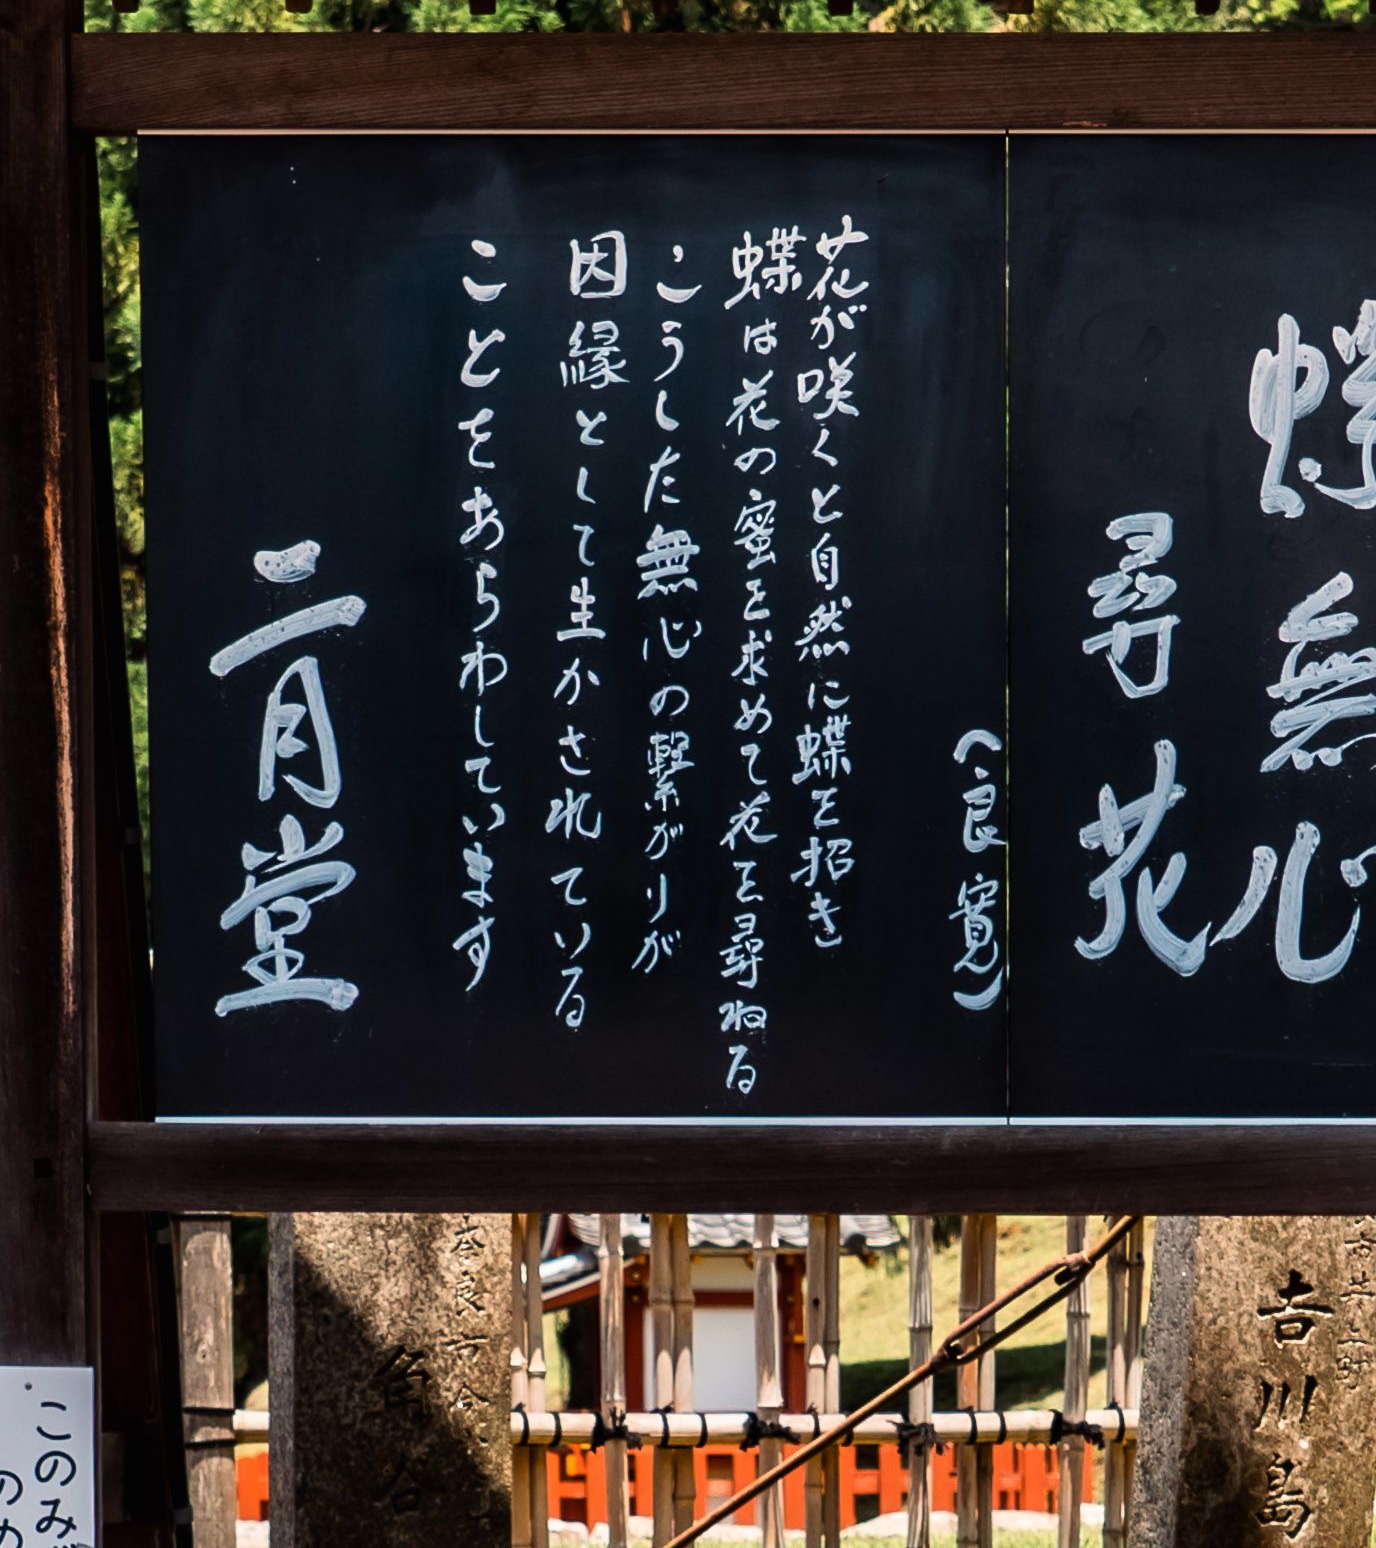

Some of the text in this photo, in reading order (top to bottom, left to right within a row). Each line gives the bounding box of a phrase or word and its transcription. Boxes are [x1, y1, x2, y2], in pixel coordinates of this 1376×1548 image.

[210, 537, 370, 1020] 二月堂
[452, 238, 508, 992] ことをあらわしています
[545, 229, 630, 1030] 因縁として生かされている
